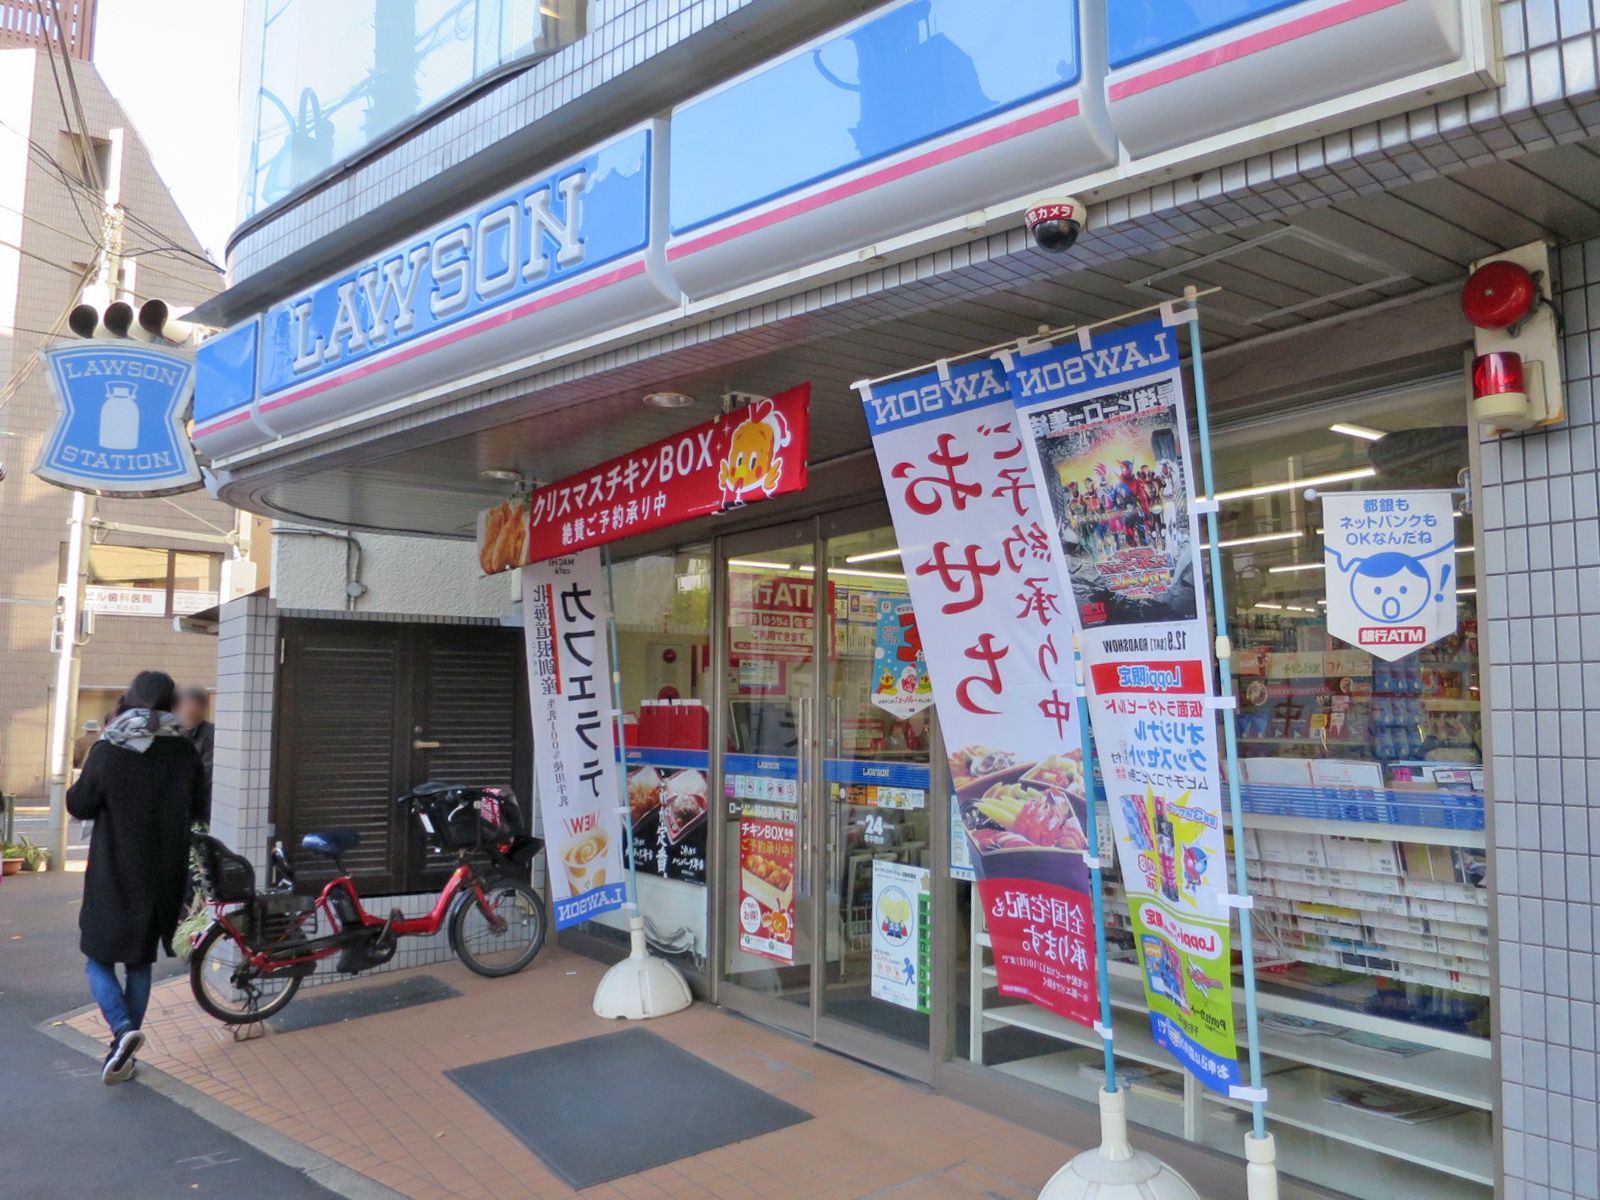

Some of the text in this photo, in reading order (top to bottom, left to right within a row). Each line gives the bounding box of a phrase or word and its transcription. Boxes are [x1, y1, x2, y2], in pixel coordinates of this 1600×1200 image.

[292, 171, 587, 375] LAWSON
[66, 359, 179, 386] LAWSON
[61, 444, 173, 471] STATION
[532, 428, 715, 527] クリスマスチキンBOX
[1363, 498, 1410, 513] 都銀も
[562, 490, 667, 546] 絶賛ご予約承り中
[1340, 513, 1437, 530] ネットバンクも
[1345, 530, 1432, 546] OKなんだね
[1361, 628, 1424, 643] 銀行ATM
[741, 823, 784, 840] チキンBOX
[864, 814, 884, 836] 24
